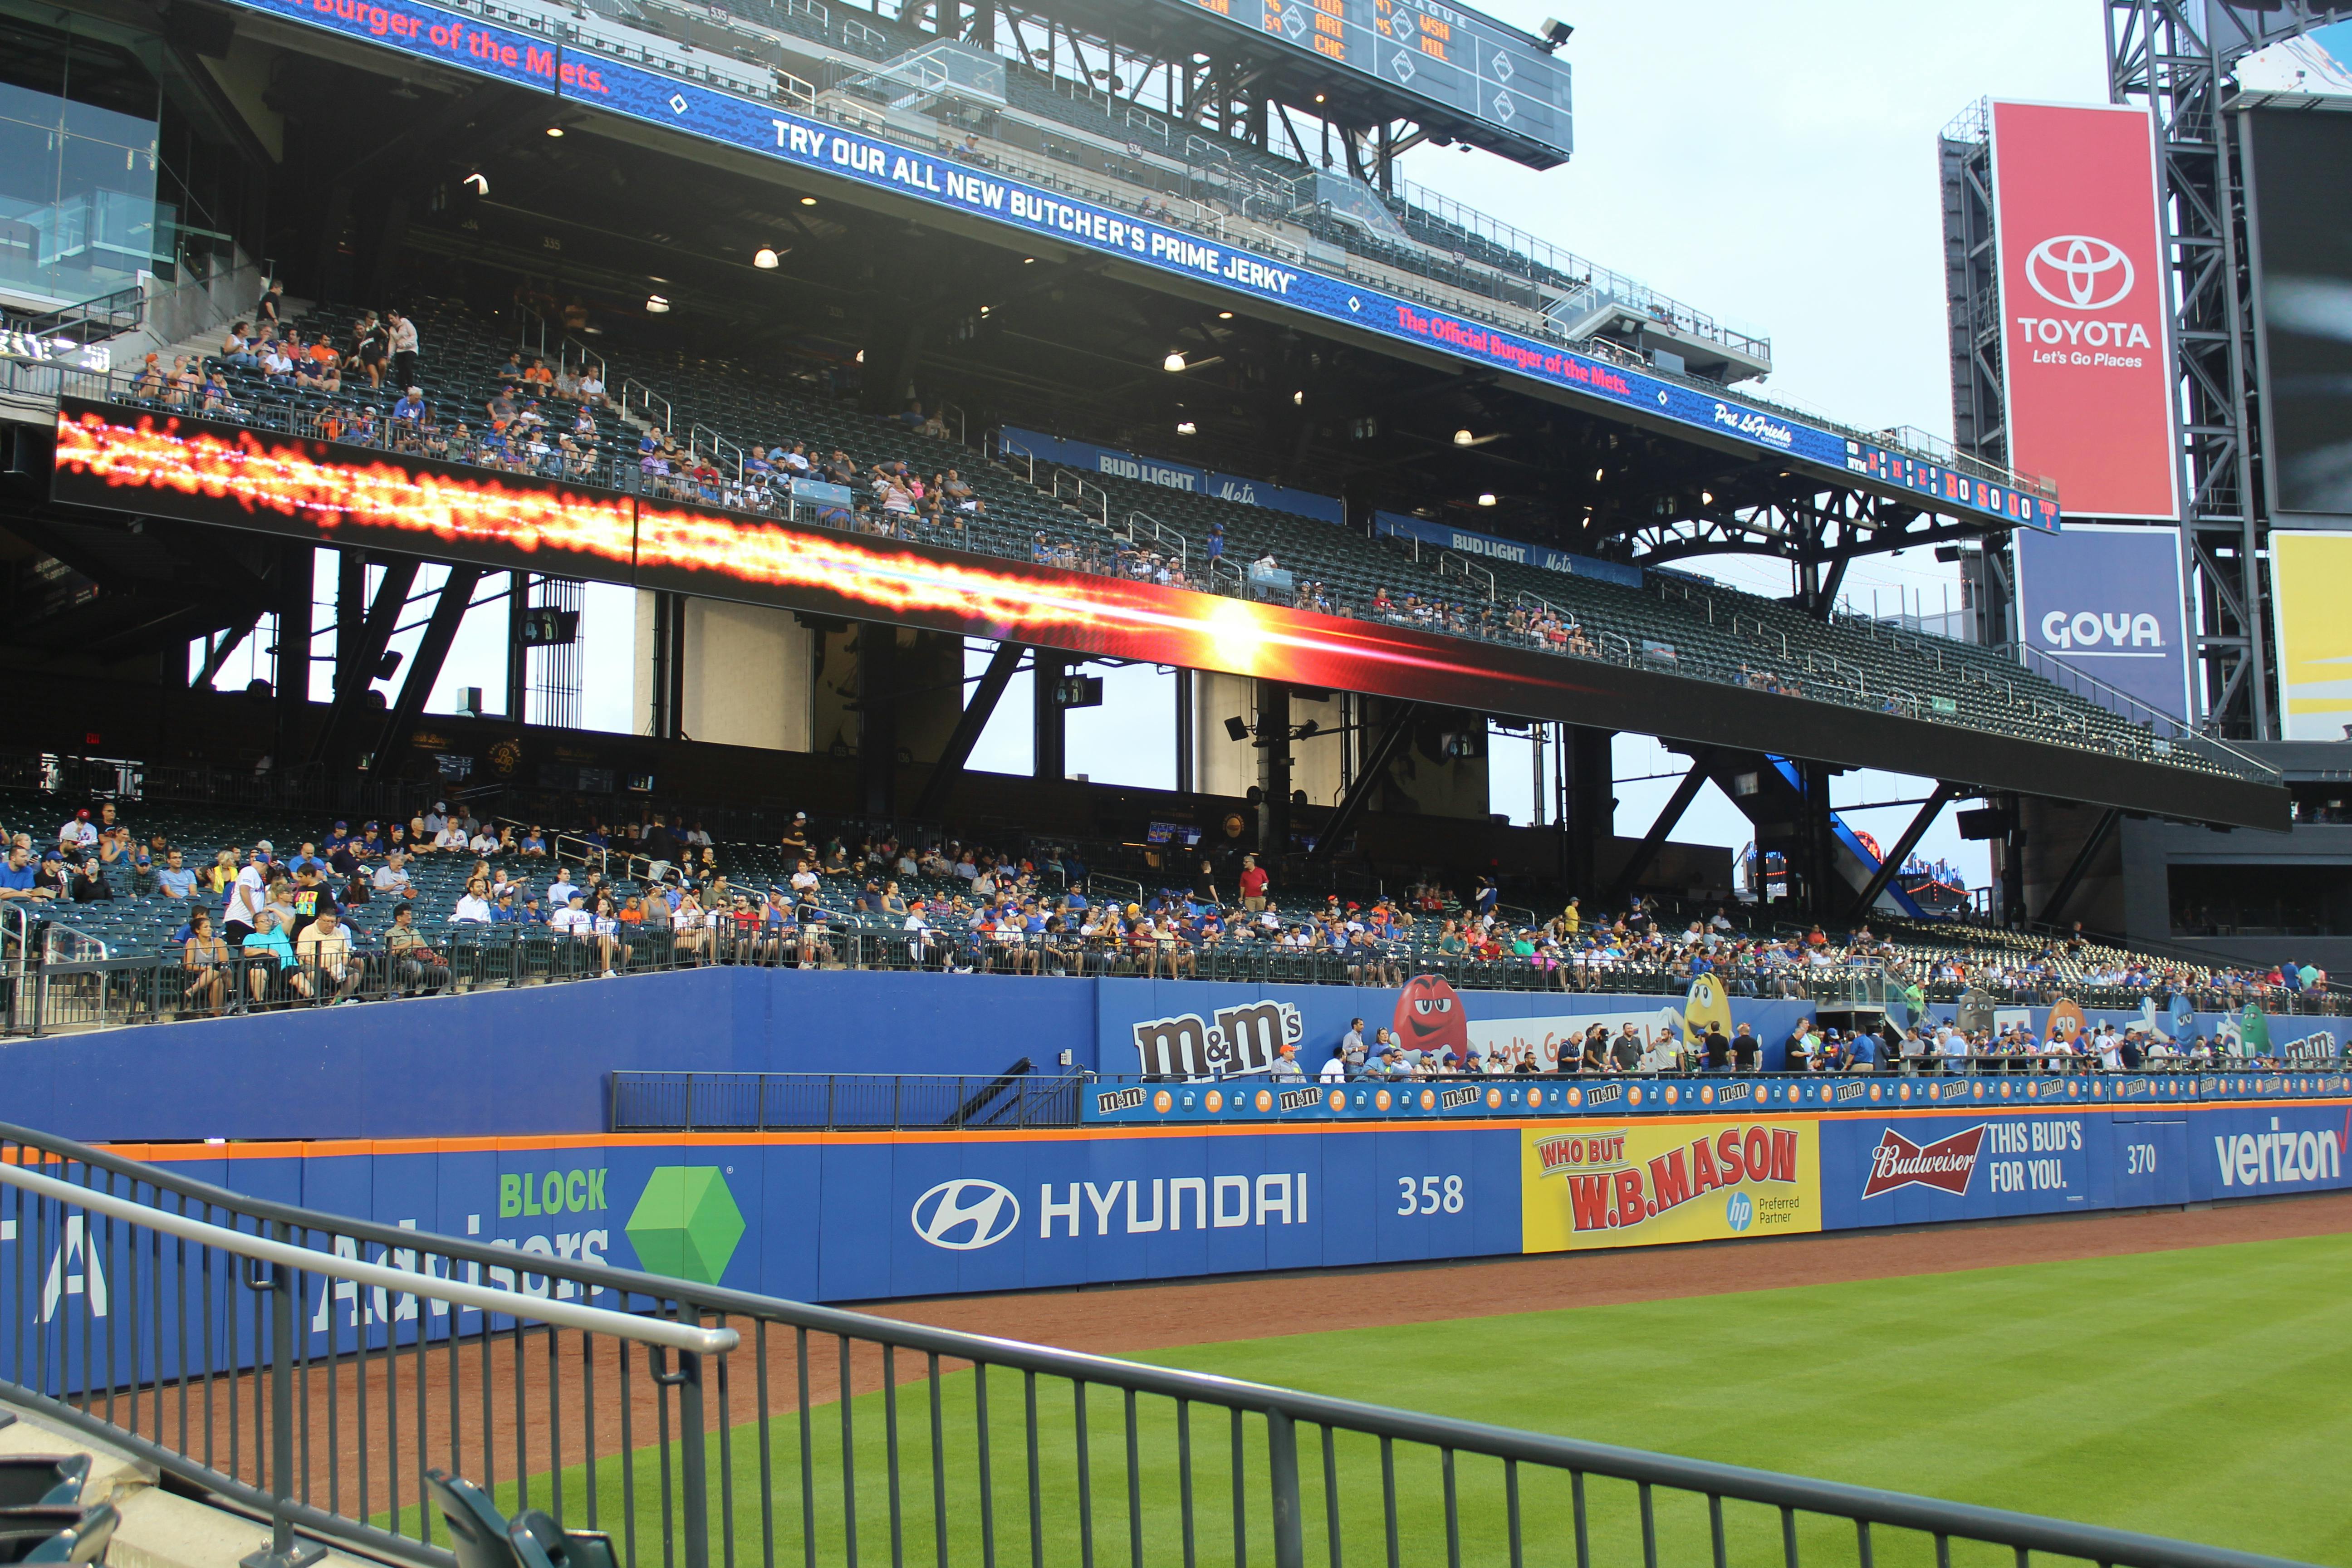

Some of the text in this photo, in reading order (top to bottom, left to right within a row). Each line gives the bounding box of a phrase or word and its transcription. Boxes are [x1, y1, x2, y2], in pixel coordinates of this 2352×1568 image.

[711, 6, 727, 21] 535
[1265, 14, 1282, 32] 59
[313, 0, 422, 37] Burger
[429, 24, 463, 50] of
[468, 31, 519, 67] the
[1315, 13, 1343, 39] ARI
[1376, 17, 1392, 36] 45
[1419, 14, 1450, 41] WSH
[1314, 34, 1345, 60] CHC
[1421, 35, 1449, 61] MIL
[1129, 143, 1142, 155] 536
[773, 118, 825, 158] TRY
[832, 137, 886, 178] OUR
[892, 157, 941, 193] ALL
[946, 170, 1005, 210] NEW
[1010, 189, 1146, 253] BUTCHER'S
[1152, 232, 1220, 275] PRIME
[544, 236, 561, 250] 335
[2017, 317, 2151, 349] TOYOTA
[1396, 306, 1631, 395] The Official Burger of the Mets.
[2033, 350, 2142, 368] Let's Go Places
[1714, 402, 1739, 428] Pat
[1738, 413, 1792, 444] LaFrieda
[1846, 441, 1859, 456] SD
[1879, 451, 1886, 464] 0
[1100, 455, 1195, 491] BUD LIGHT
[1847, 456, 1867, 474] NYM
[1868, 452, 1877, 471] R
[1880, 466, 1886, 480] 0
[1892, 460, 1902, 478] H
[1906, 459, 1913, 472] 0
[1930, 466, 1936, 480] 0
[1906, 474, 1914, 488] 0
[1918, 468, 1926, 485] E
[1930, 481, 1937, 495] 0
[1220, 482, 1255, 505] Mets
[1945, 473, 1958, 498] B
[1959, 478, 1970, 501] 0
[1977, 483, 1989, 508] S
[1990, 488, 2001, 510] 0
[2039, 500, 2057, 516] TOP
[2045, 515, 2052, 529] 1
[1452, 534, 1525, 564] BUD LIGHT
[1543, 554, 1573, 573] Mets
[2041, 610, 2161, 649] GOYA
[1988, 1119, 2082, 1154] THIS BUD'S
[1540, 1137, 1625, 1168] WHO BUT
[1872, 1144, 1976, 1179] Budweiser
[2127, 1143, 2156, 1175] 370
[2215, 1117, 2339, 1186] verizon
[1989, 1158, 2068, 1193] FOR YOU.
[500, 1168, 608, 1219] BLOCK
[1040, 1172, 1308, 1239] HYUNDAI
[1397, 1175, 1465, 1216] 358
[1759, 1196, 1799, 1210] Preferred
[1729, 1193, 1750, 1231] hp
[1759, 1211, 1791, 1224] Partner
